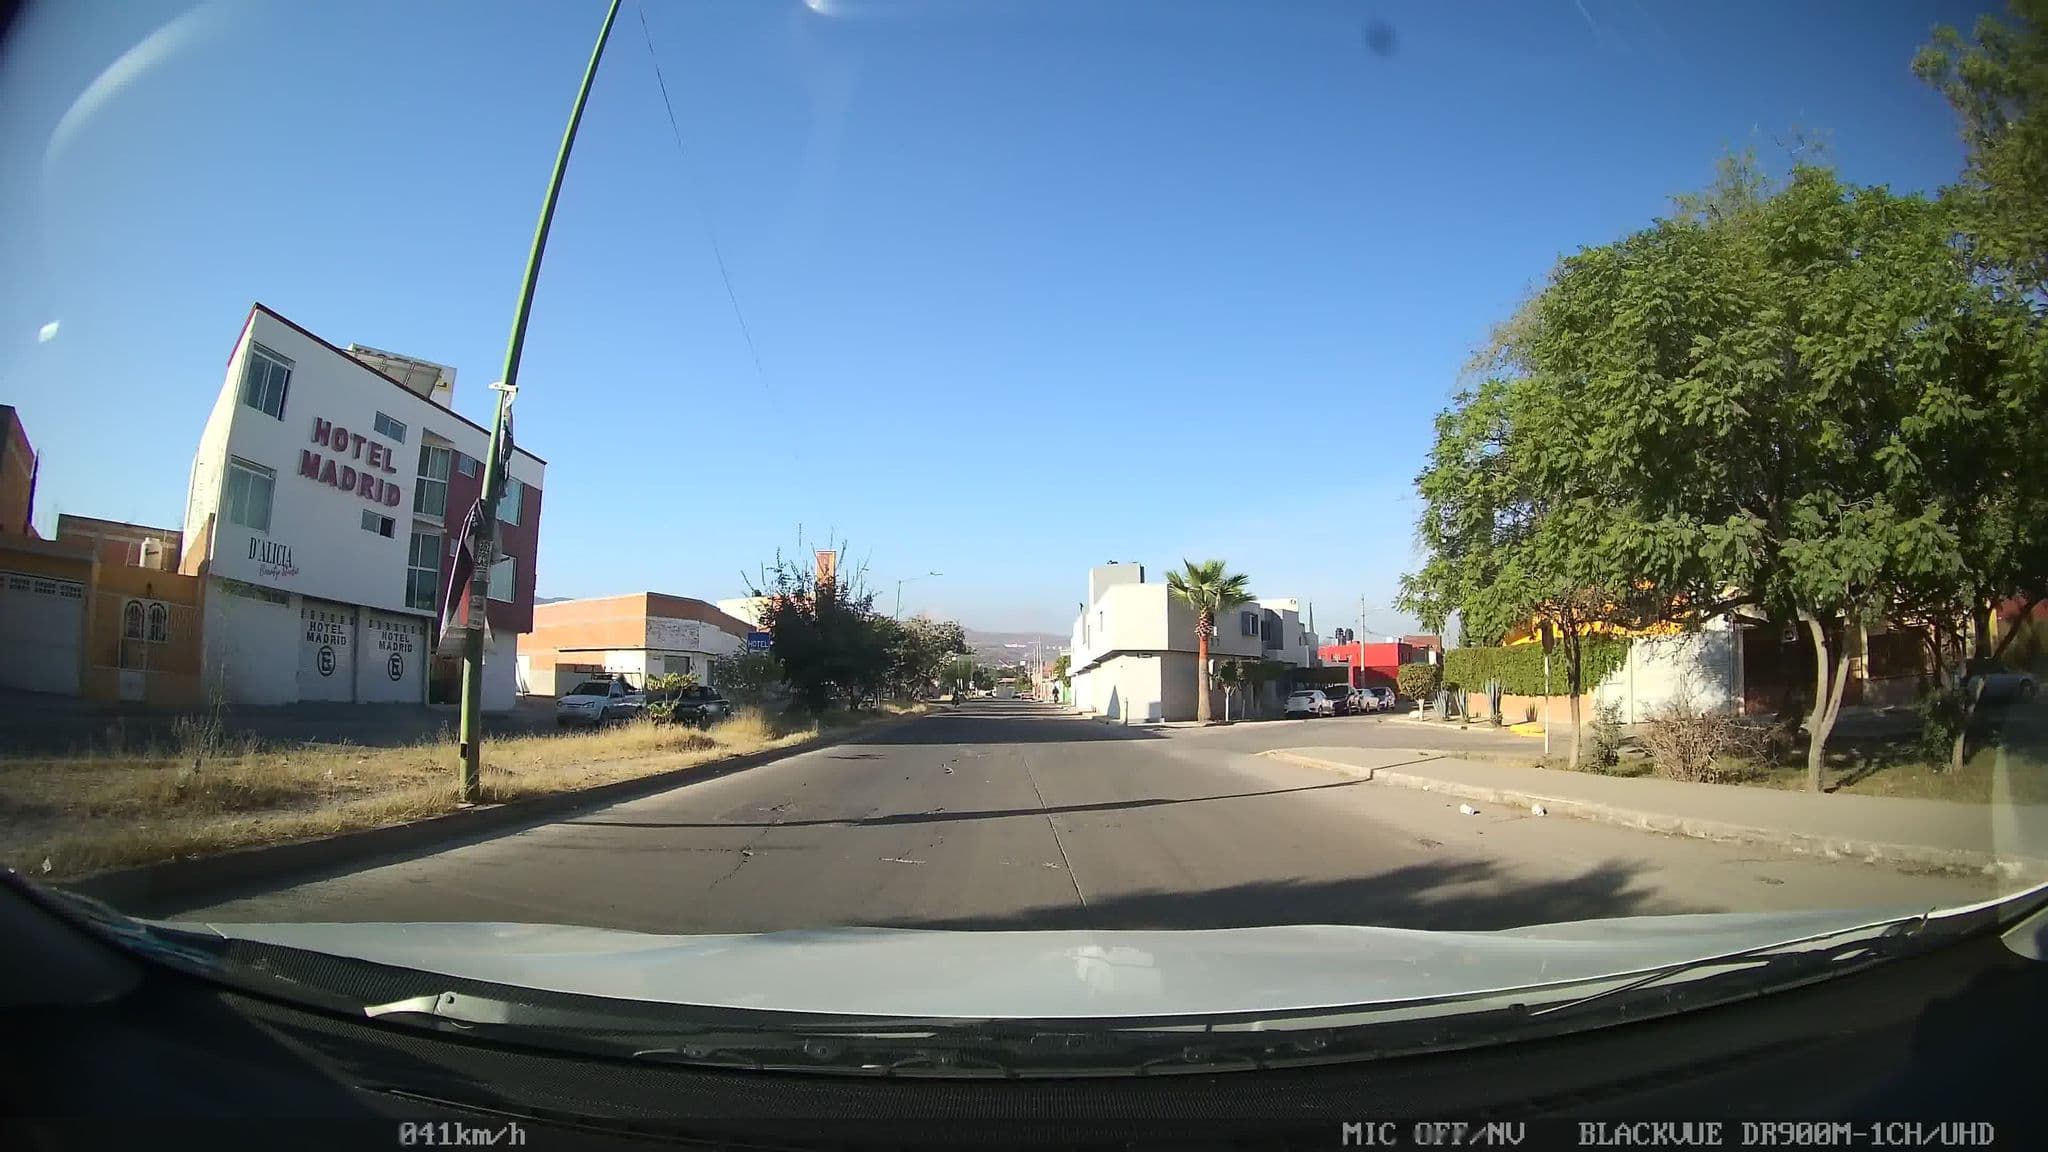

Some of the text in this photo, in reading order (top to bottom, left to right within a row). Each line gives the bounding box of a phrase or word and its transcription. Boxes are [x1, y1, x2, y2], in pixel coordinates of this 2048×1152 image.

[311, 416, 397, 474] HOTEL
[298, 448, 401, 507] MADRID
[248, 537, 292, 568] D'ALICIA
[309, 620, 344, 635] HOTEL
[306, 632, 347, 646] MADRID
[382, 631, 410, 643] HOTEL
[747, 640, 769, 648] HOTEL
[378, 640, 413, 653] MADRID
